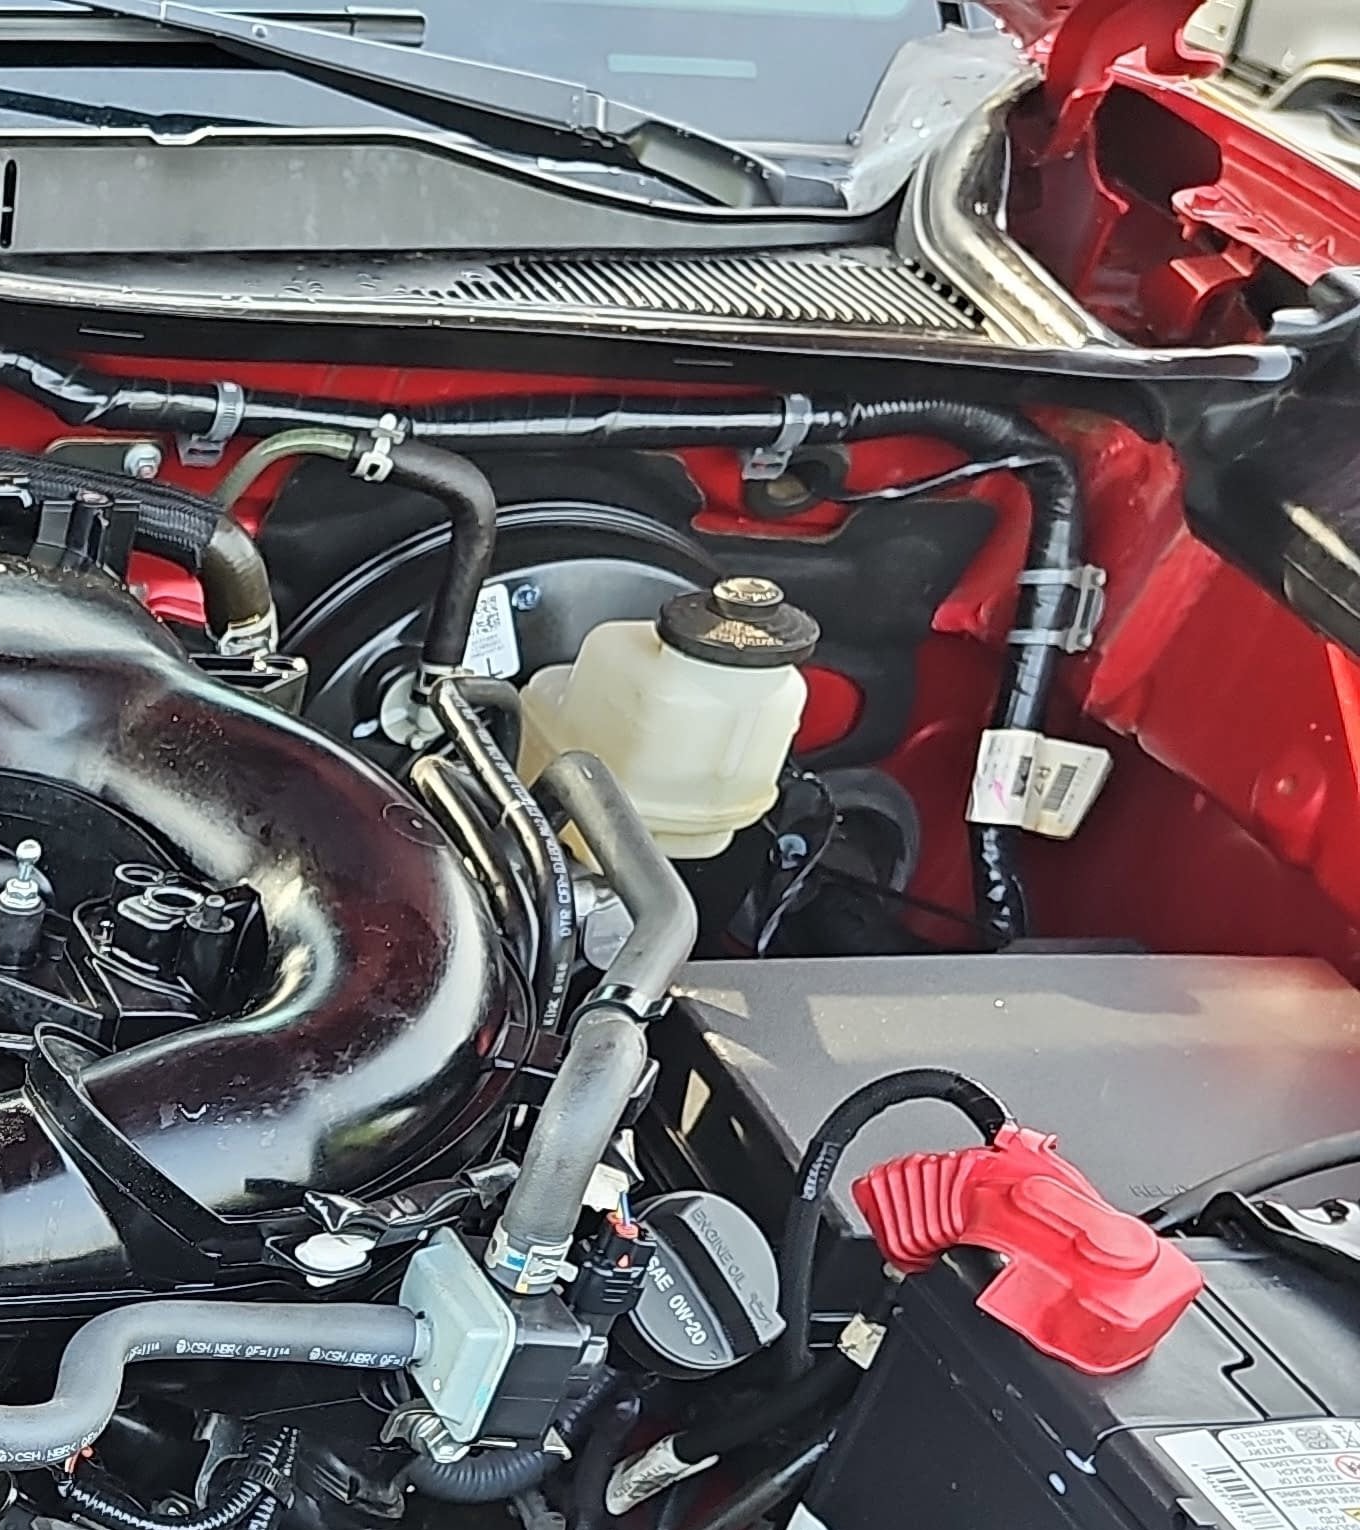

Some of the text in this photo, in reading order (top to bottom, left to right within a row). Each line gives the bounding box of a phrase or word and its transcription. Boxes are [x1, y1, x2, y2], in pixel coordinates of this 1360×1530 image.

[691, 1207, 746, 1290] ENGINE OIL
[646, 1255, 708, 1346] SAE 0W-20
[1230, 1429, 1285, 1441] RECYCLED
[1257, 1438, 1287, 1447] MUST
[1248, 1445, 1295, 1456] BATTERY
[1259, 1458, 1313, 1469] CHILDREN
